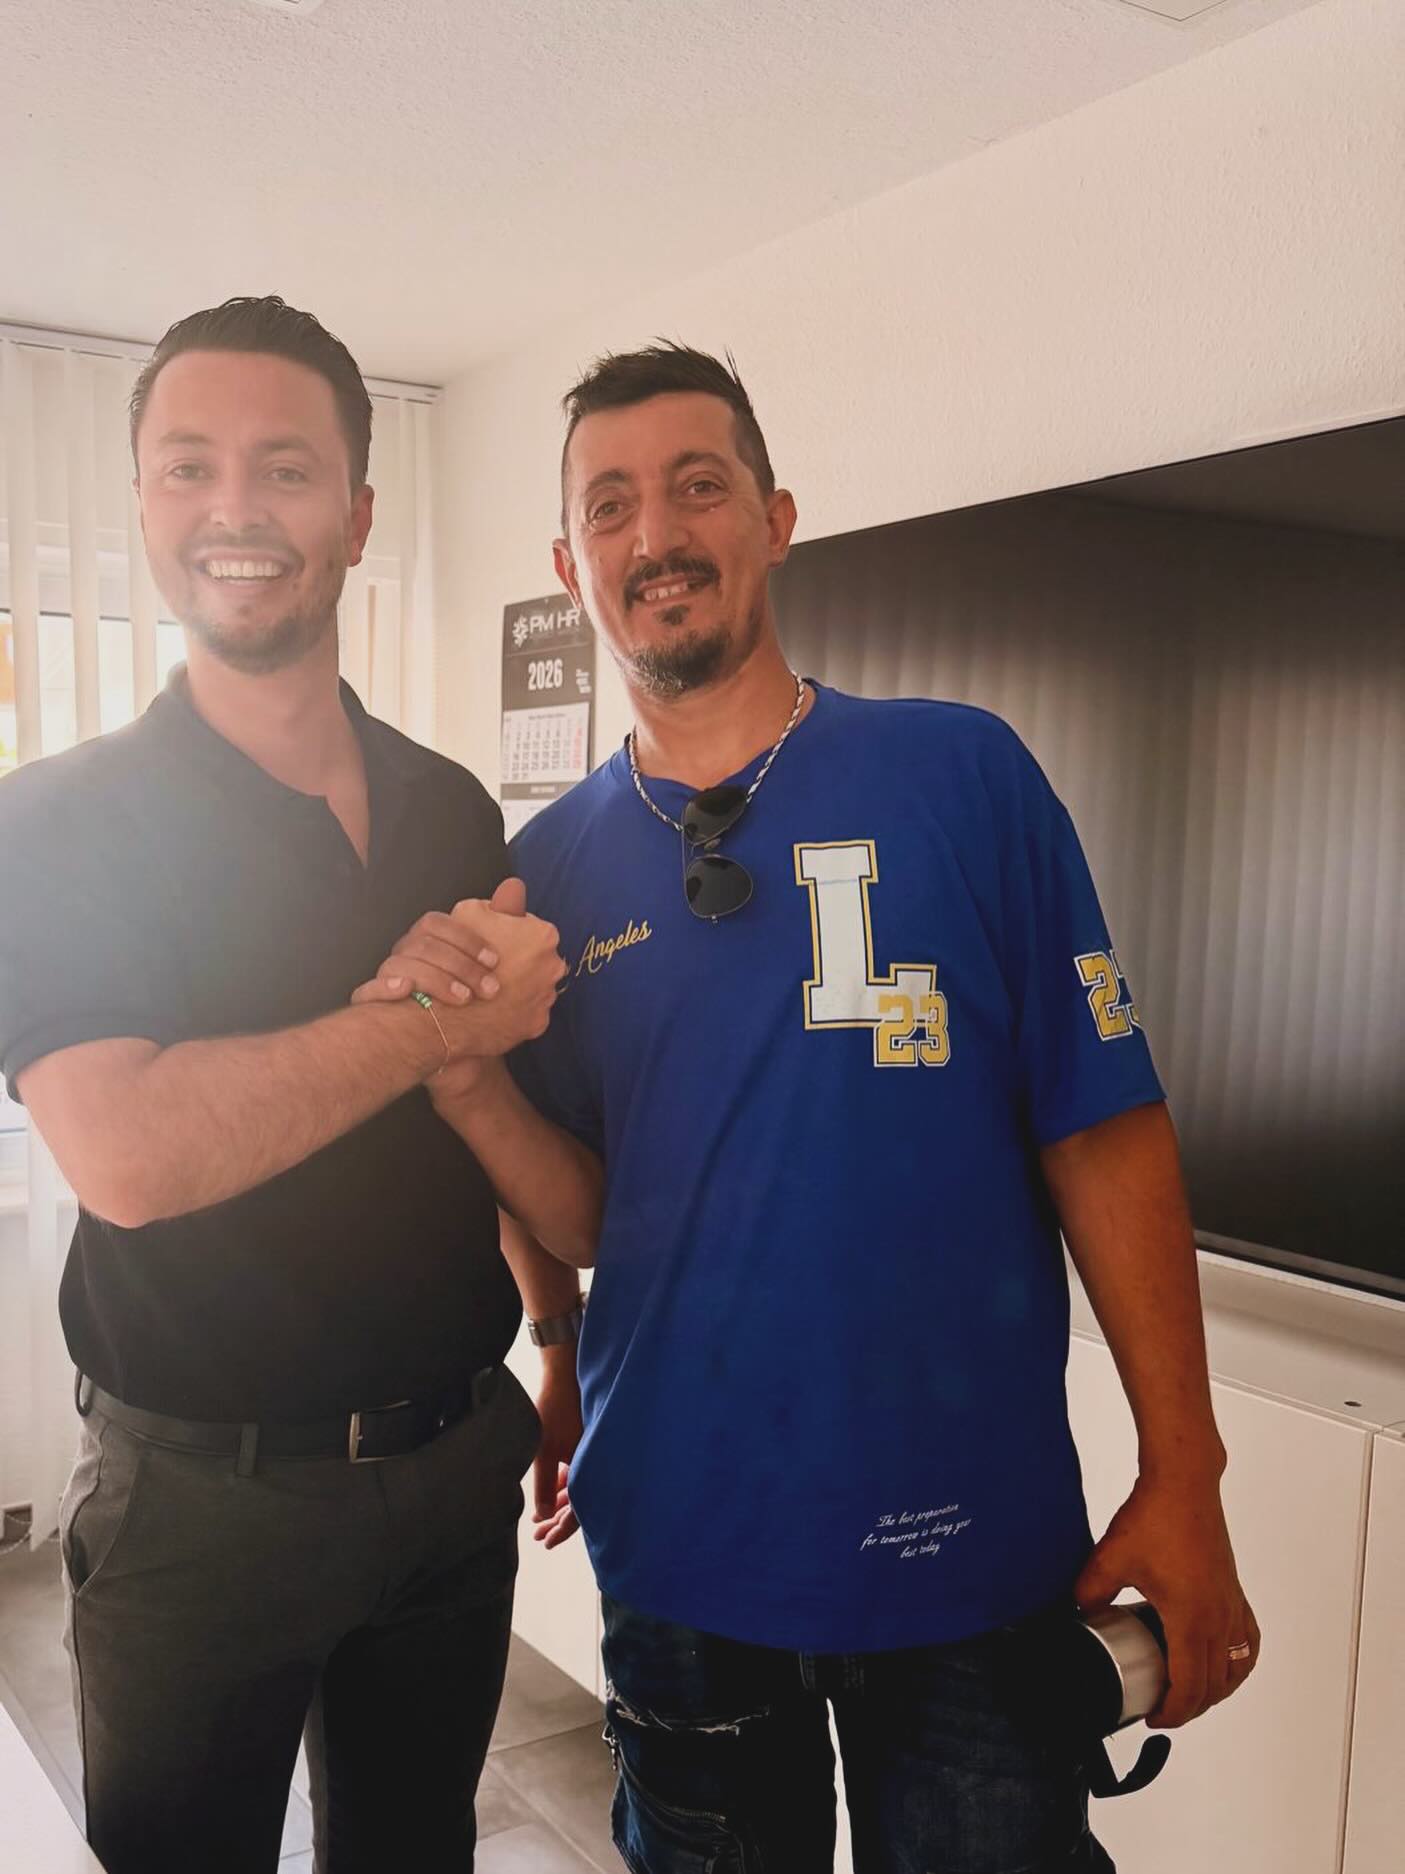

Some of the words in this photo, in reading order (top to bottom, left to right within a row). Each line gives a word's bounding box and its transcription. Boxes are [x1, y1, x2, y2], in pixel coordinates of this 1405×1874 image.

[529, 613, 554, 634] PM
[557, 608, 581, 629] HR
[528, 658, 563, 690] 2026
[576, 919, 652, 976] Angeles
[793, 839, 937, 1030] L
[874, 991, 950, 1067] 23
[876, 1513, 896, 1527] The
[860, 1533, 877, 1551] for
[880, 1532, 919, 1544] tomorrow
[900, 1546, 918, 1558] best
